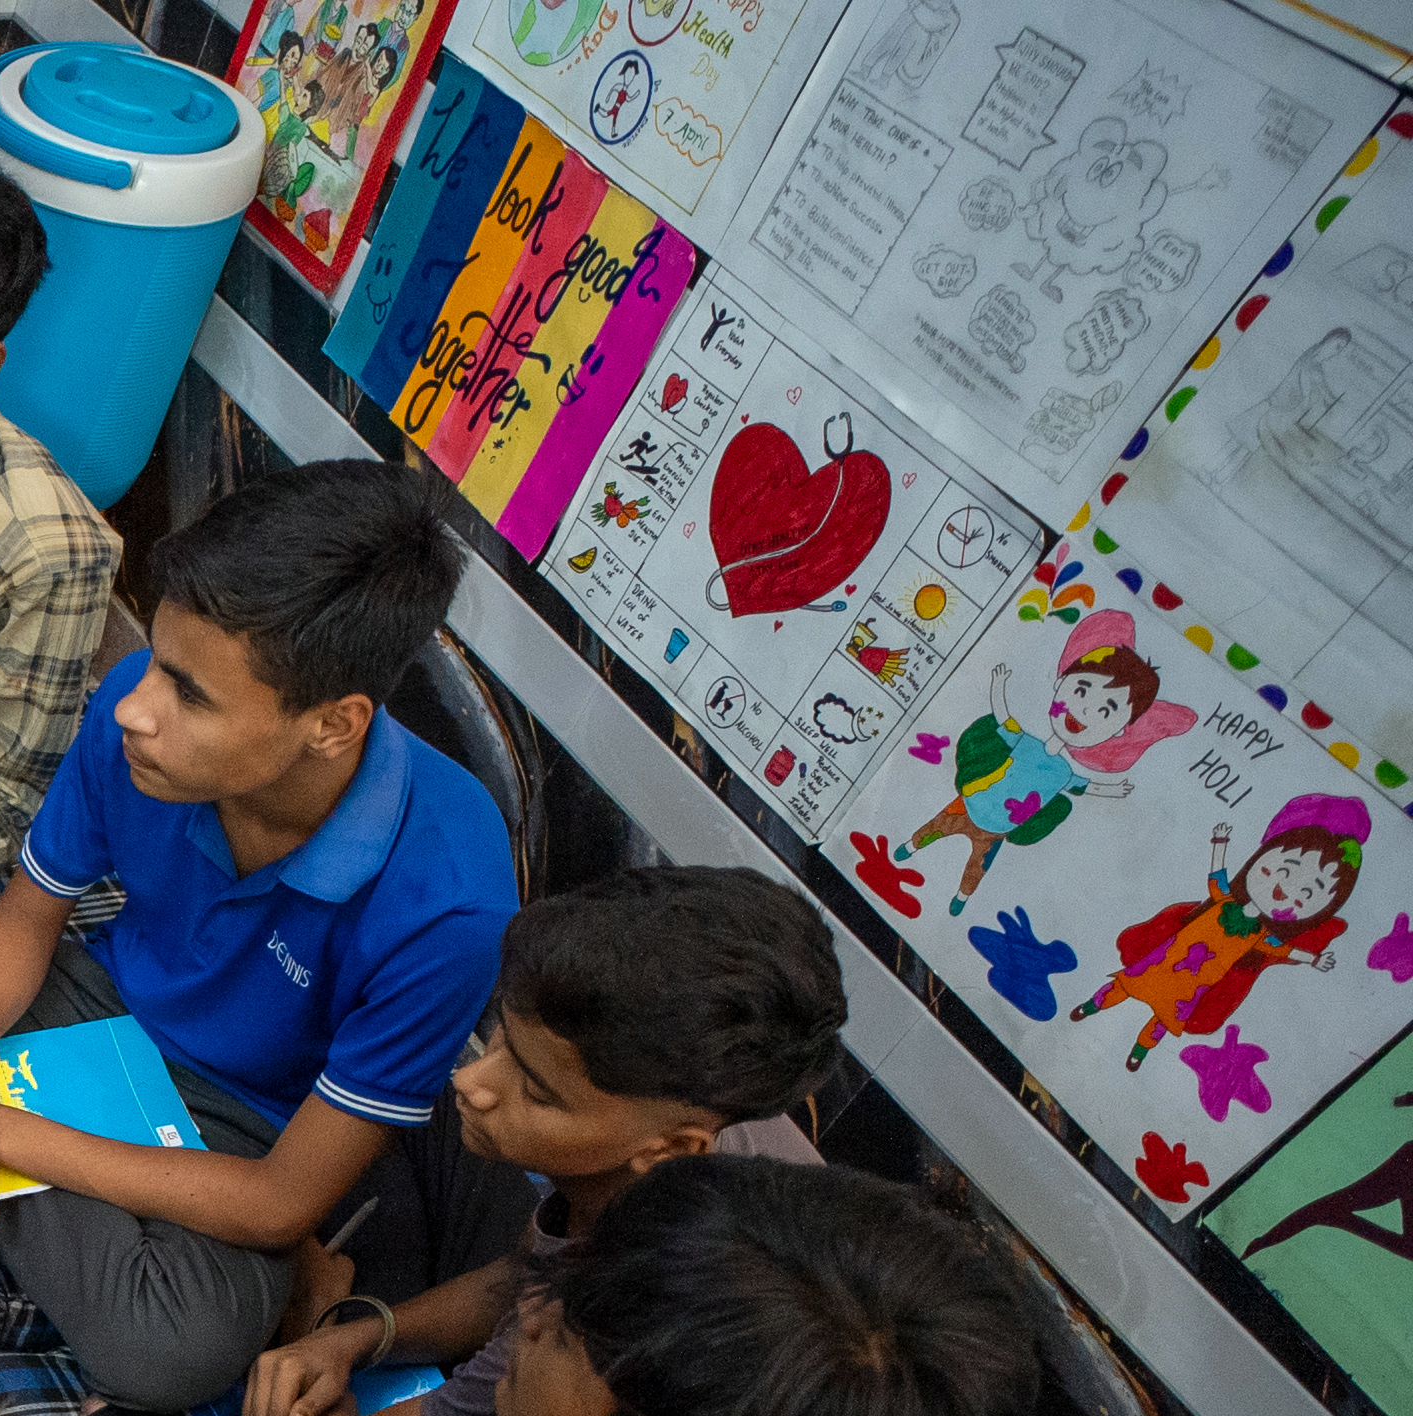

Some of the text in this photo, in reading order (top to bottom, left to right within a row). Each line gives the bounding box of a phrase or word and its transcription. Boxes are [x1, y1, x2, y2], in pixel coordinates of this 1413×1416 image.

[682, 10, 735, 59] Health
[690, 53, 721, 92] Day
[675, 122, 709, 151] April
[829, 113, 850, 135] YOUR
[863, 106, 885, 129] TAKE
[888, 125, 910, 145] CARE
[484, 141, 661, 323] look good
[842, 264, 858, 282] and
[652, 510, 666, 524] EAT
[628, 529, 647, 547] DIET
[586, 588, 595, 598] C
[632, 583, 658, 612] DRINK
[616, 616, 644, 642] WATER
[734, 720, 764, 752] ALCOHOL
[794, 717, 839, 760] SLEEP WELL
[1203, 701, 1285, 760] HAPPY
[810, 769, 830, 789] SALT
[1188, 748, 1253, 809] HOLI
[267, 929, 312, 988] DENNIS
